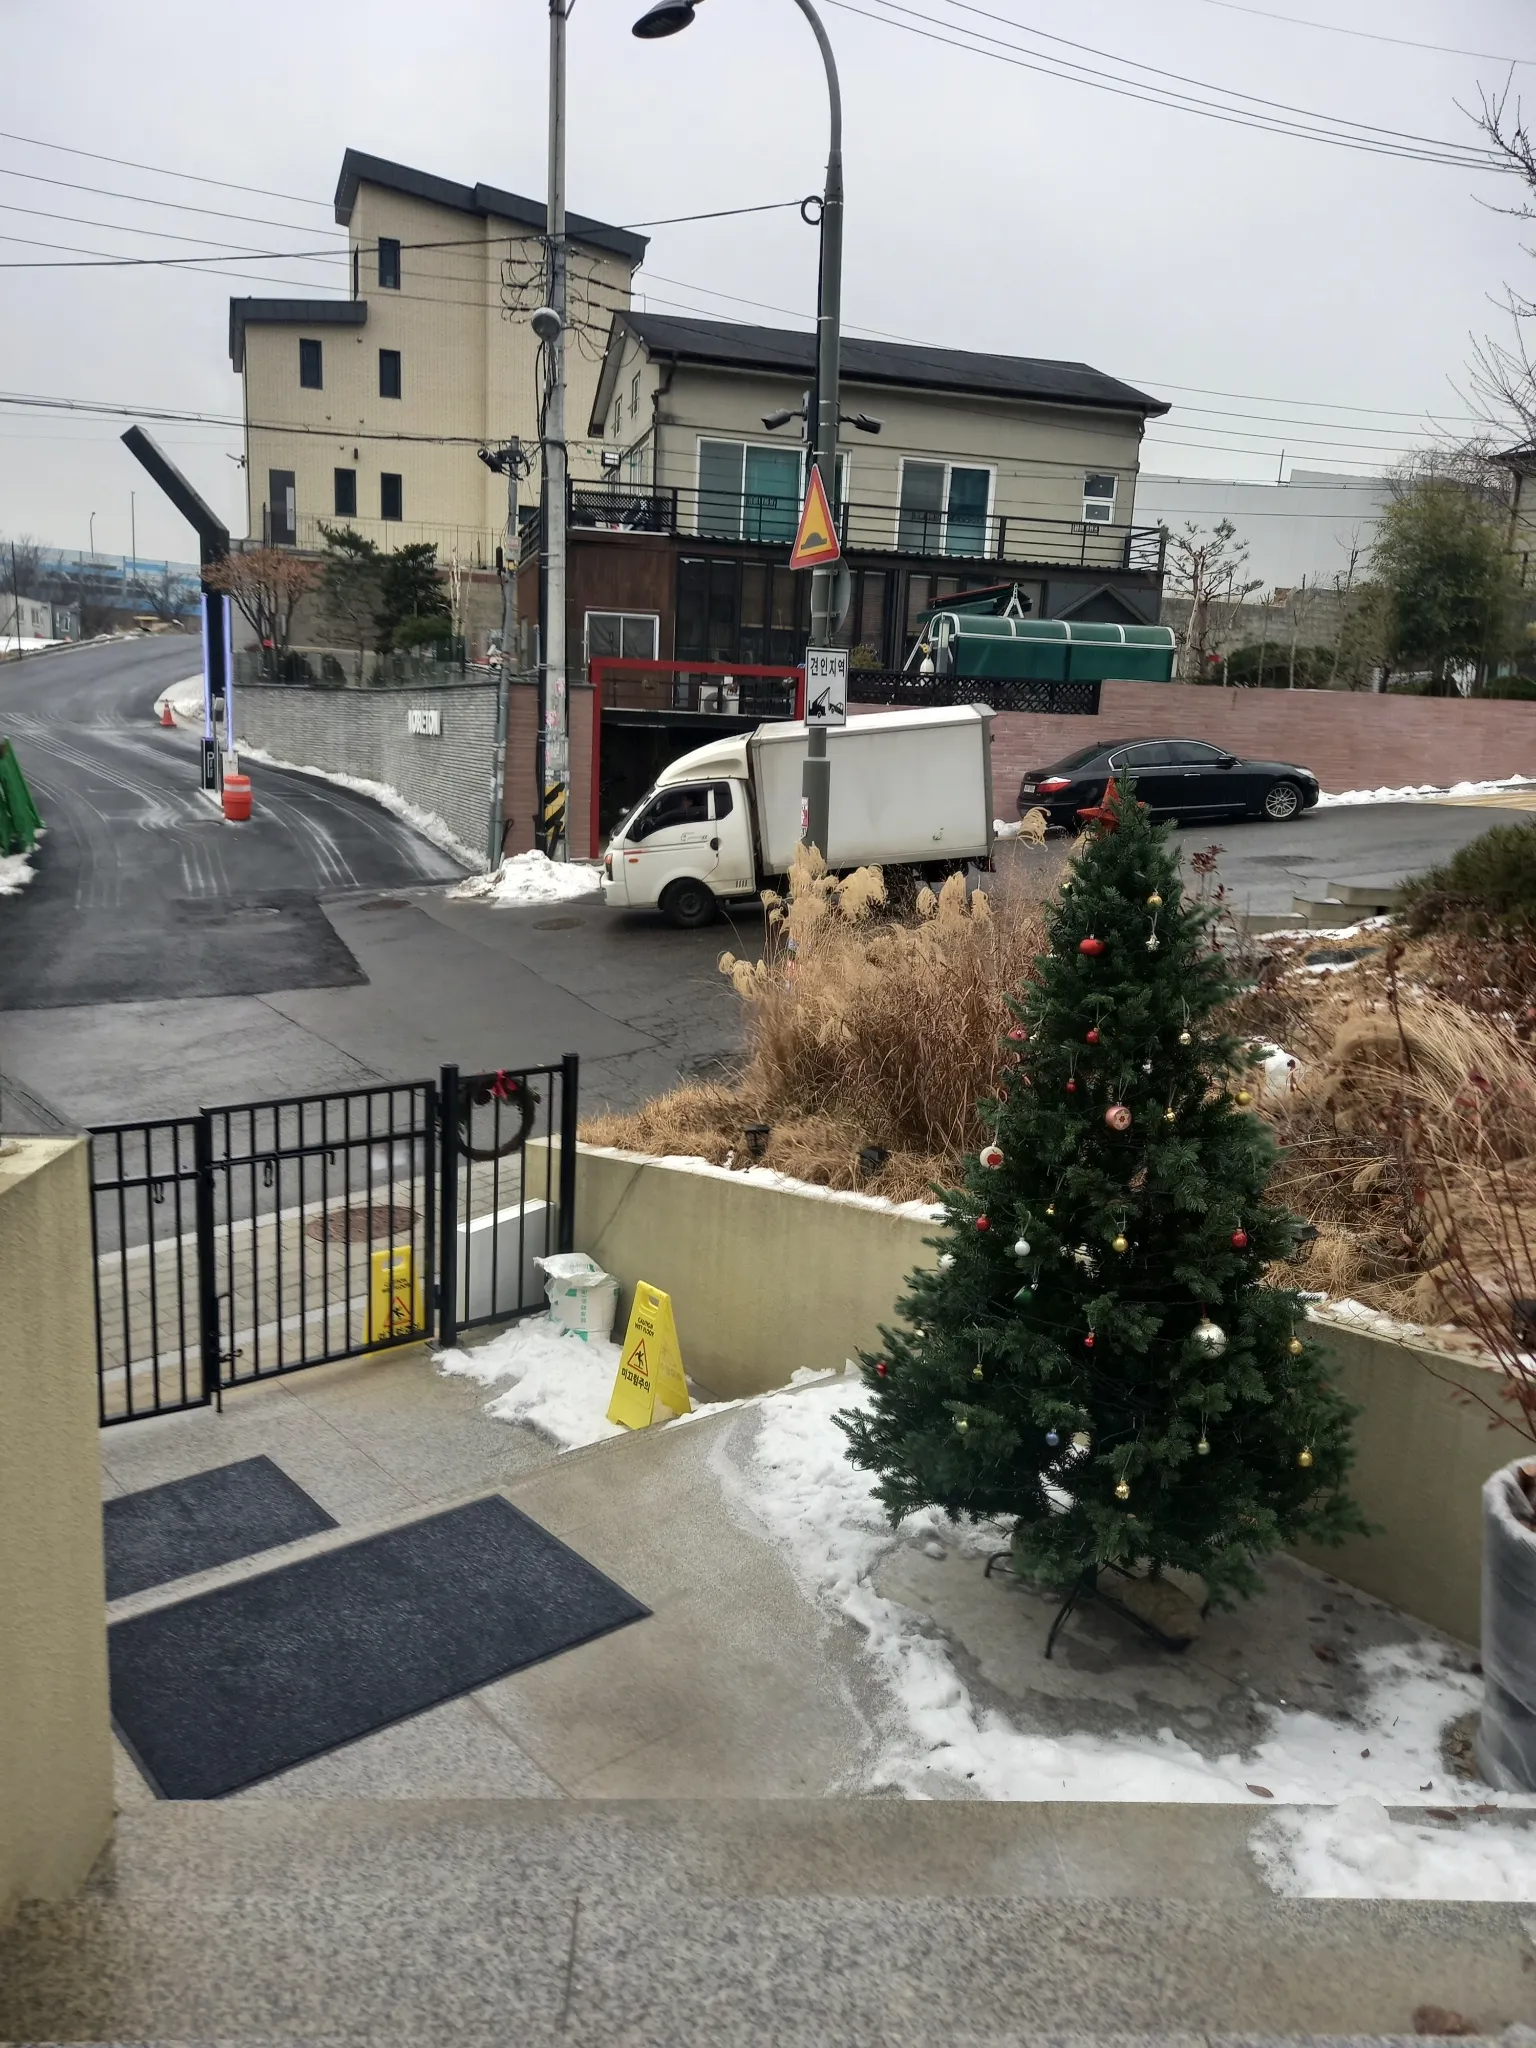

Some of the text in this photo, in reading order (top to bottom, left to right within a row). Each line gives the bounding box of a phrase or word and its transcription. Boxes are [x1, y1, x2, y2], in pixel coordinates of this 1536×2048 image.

[810, 656, 845, 677] 견인지역
[634, 1322, 655, 1338] WET FLOOR
[621, 1367, 651, 1393] 미끄럼주의
